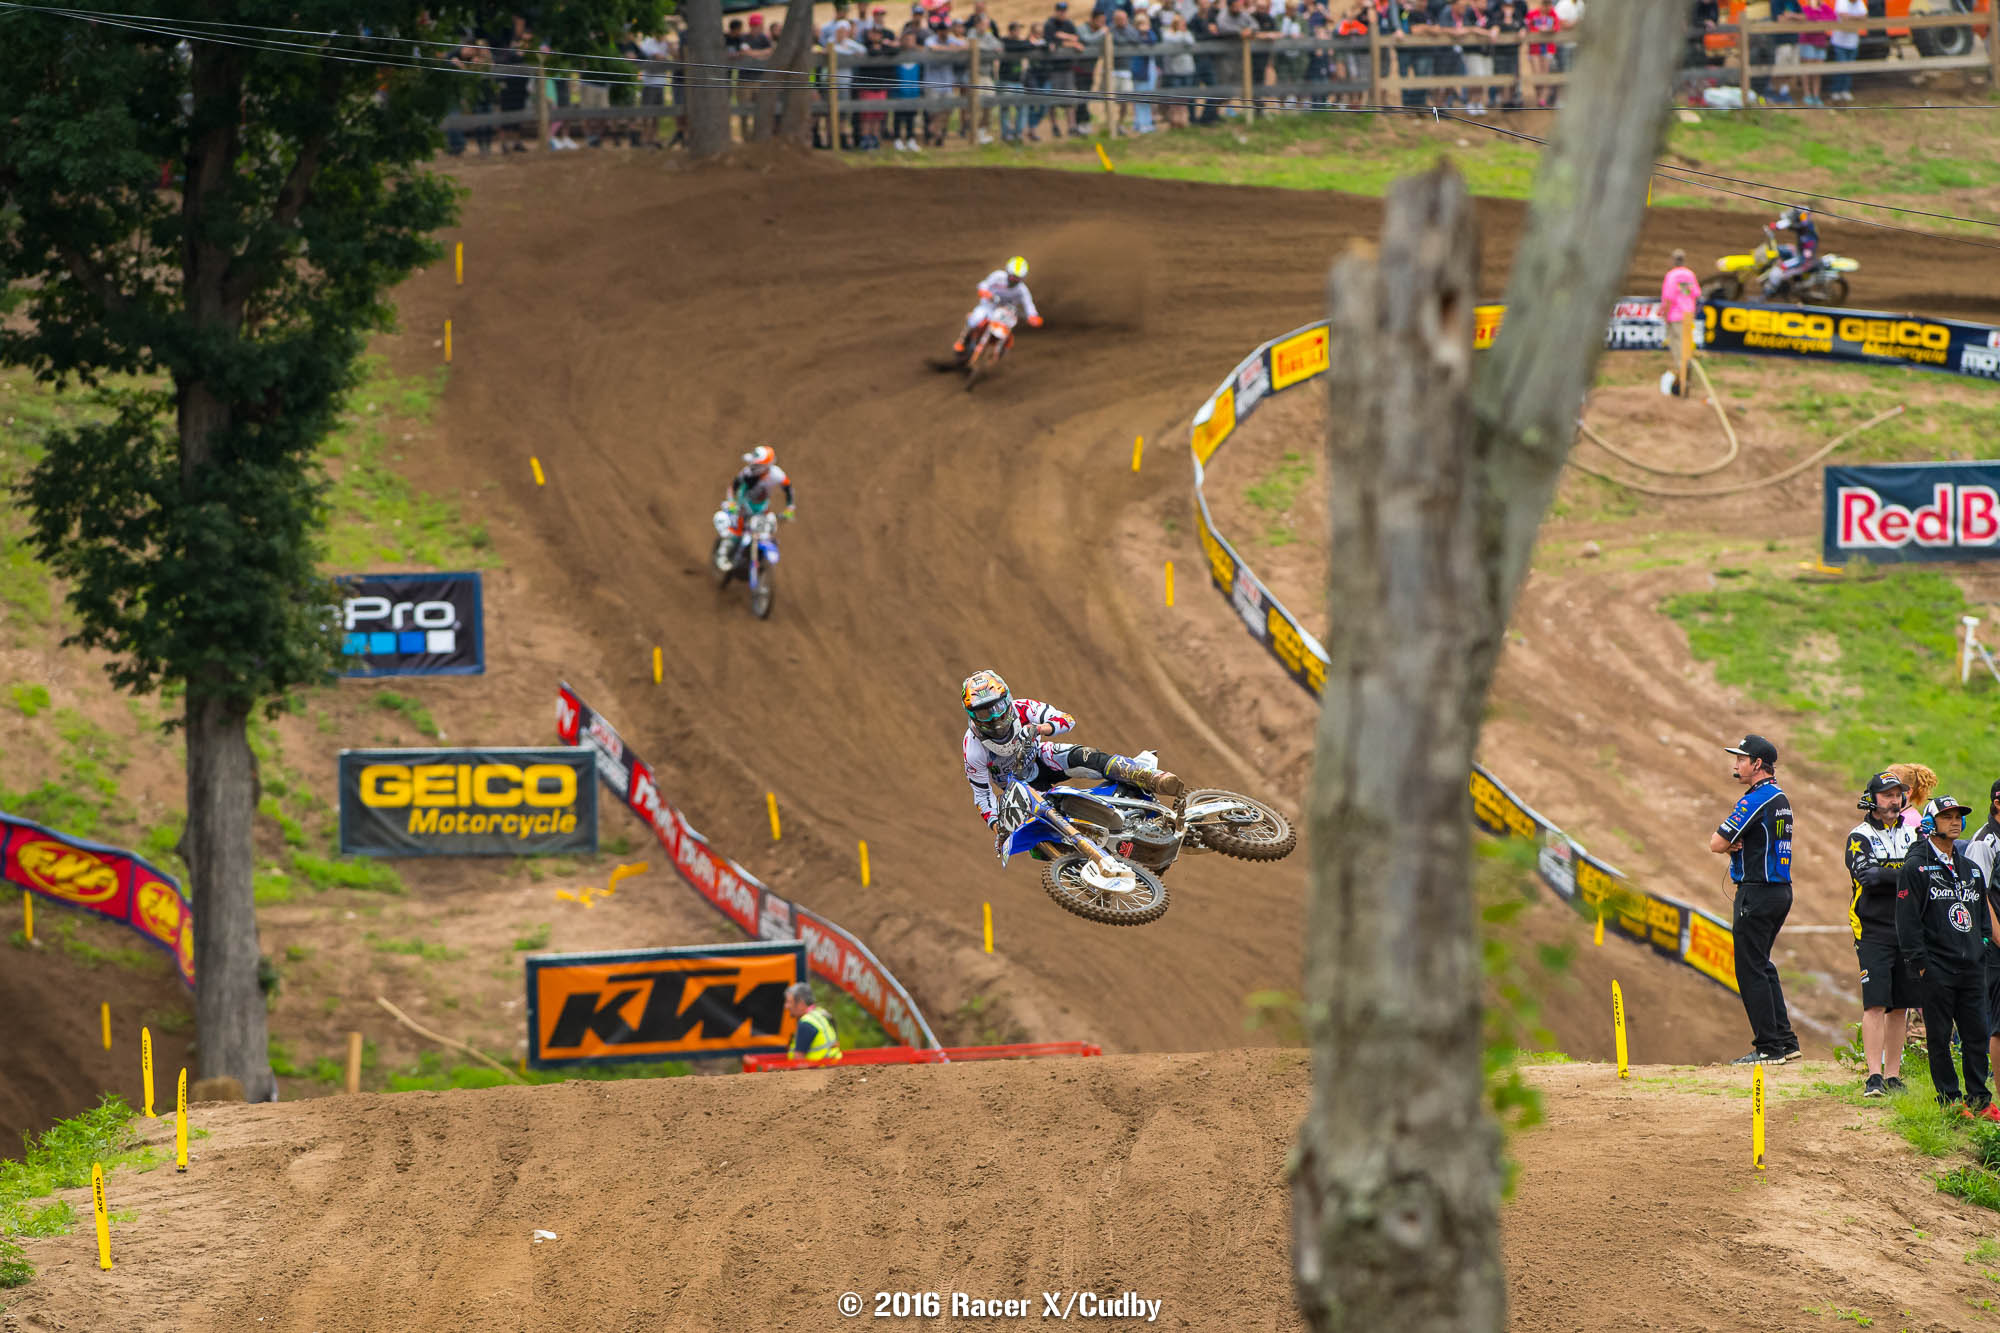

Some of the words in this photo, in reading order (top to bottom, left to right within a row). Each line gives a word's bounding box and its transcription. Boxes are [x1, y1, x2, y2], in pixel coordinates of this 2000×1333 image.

[1721, 307, 1834, 339] GEICO
[1838, 317, 1950, 349] GEICO
[1743, 331, 1833, 354] Motorcycle
[1861, 341, 1948, 364] Motorcycle
[358, 764, 578, 808] GEICO
[408, 808, 578, 840] Motorcycle
[547, 967, 790, 1048] KTM
[1613, 992, 1622, 1028] ACERBIS
[95, 1176, 104, 1214] ACERBIS
